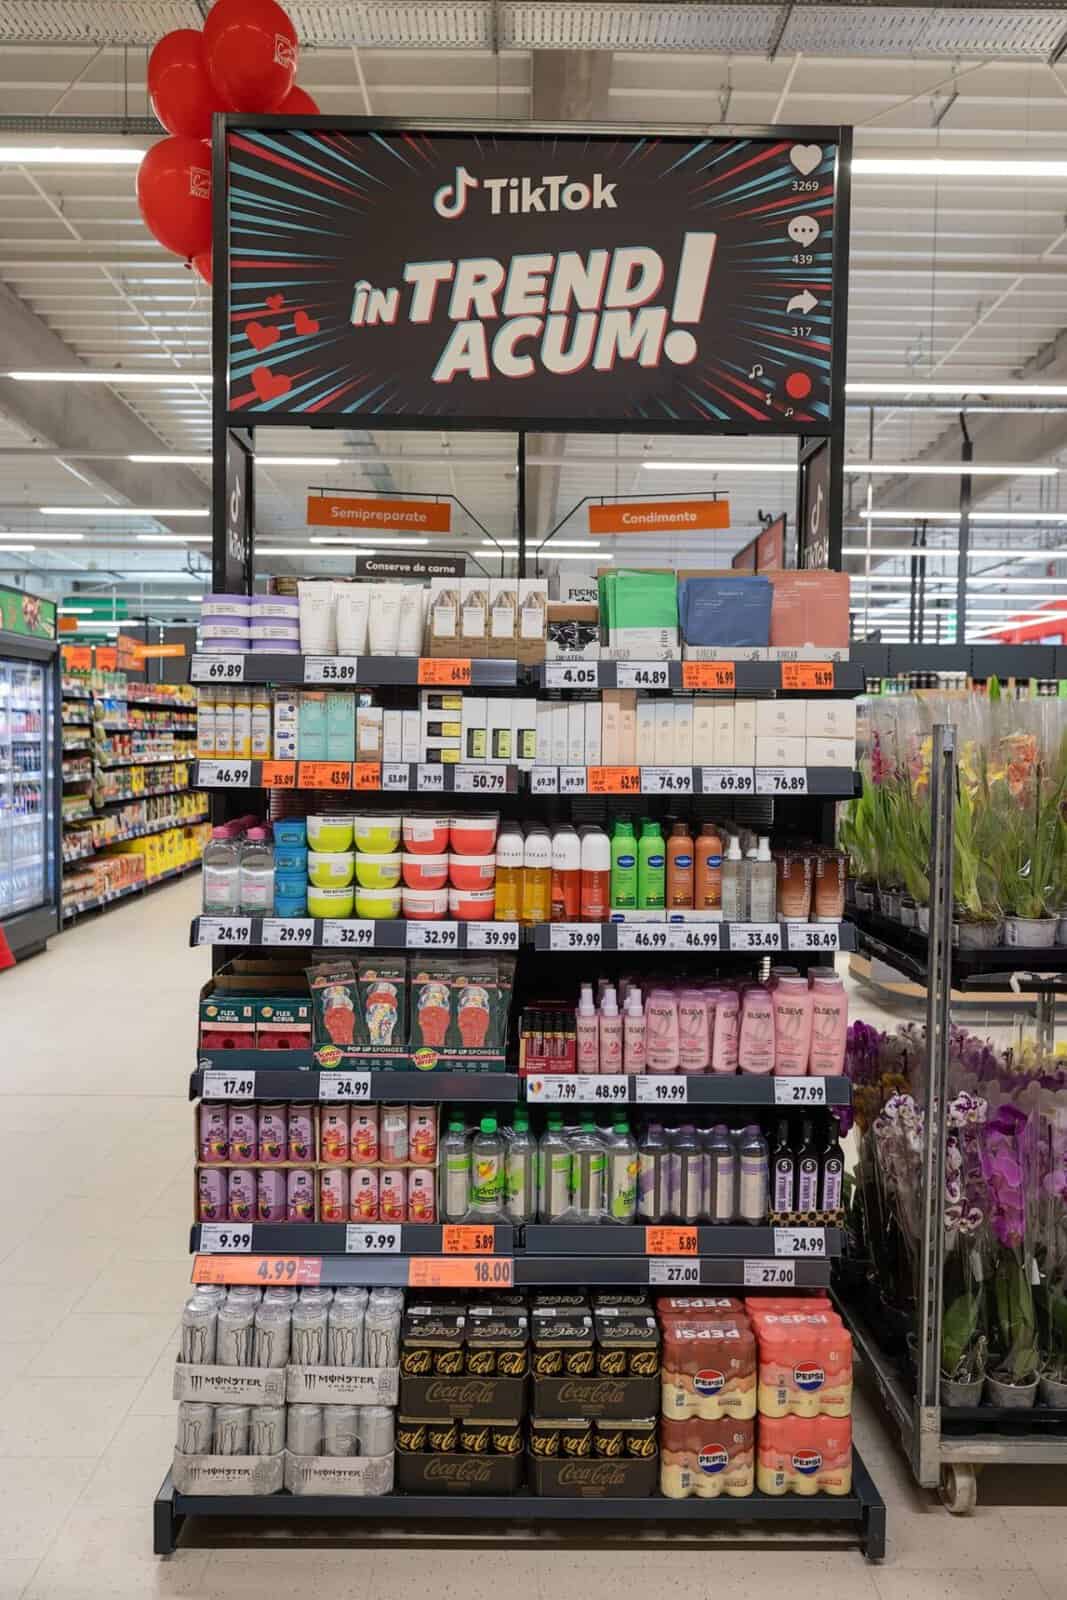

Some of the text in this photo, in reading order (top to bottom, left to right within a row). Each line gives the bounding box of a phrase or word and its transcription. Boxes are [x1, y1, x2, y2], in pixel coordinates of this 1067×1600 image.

[791, 180, 820, 192] 3269
[483, 173, 618, 215] TikTok
[791, 254, 813, 265] 439
[791, 326, 812, 337] 317
[330, 506, 428, 523] Semipreparate
[365, 560, 456, 574] Conserve de carne
[209, 664, 241, 677] 69.89
[322, 666, 355, 678] 53.89
[563, 670, 596, 682] 4.05
[634, 671, 666, 684] 44.89
[216, 770, 249, 782] 46.99
[472, 775, 505, 788] 50.79
[659, 776, 691, 789] 74.99
[720, 777, 752, 789] 69.89
[773, 777, 805, 789] 76.89
[217, 927, 249, 940] 24.19
[279, 928, 312, 941] 29.99
[340, 929, 373, 942] 32.99
[424, 930, 456, 944] 32.99
[485, 932, 517, 944] 39.99
[568, 933, 600, 946] 39.99
[635, 933, 667, 946] 46.99
[686, 933, 717, 946] 46.99
[747, 933, 779, 946] 33.49
[805, 933, 837, 946] 38.49
[223, 1080, 254, 1094] 17.49
[337, 1081, 369, 1095] 24.99
[558, 1084, 576, 1099] 7.99
[595, 1085, 627, 1098] 48.99
[655, 1085, 686, 1099] 19.99
[792, 1086, 824, 1100] 27.99
[219, 1234, 250, 1248] 9.99
[364, 1234, 396, 1249] 9.99
[678, 1236, 697, 1250] 5.89
[792, 1238, 824, 1251] 24.99
[256, 1260, 297, 1280] 4.99
[474, 1261, 511, 1282] 18.00
[667, 1268, 699, 1281] 27.00
[762, 1269, 793, 1282] 27.00
[205, 1376, 262, 1387] MONSTER
[318, 1374, 375, 1385] MONSTER
[795, 1372, 824, 1380] PEPSI
[699, 1455, 728, 1463] PEPSI
[792, 1457, 821, 1465] PEPSI
